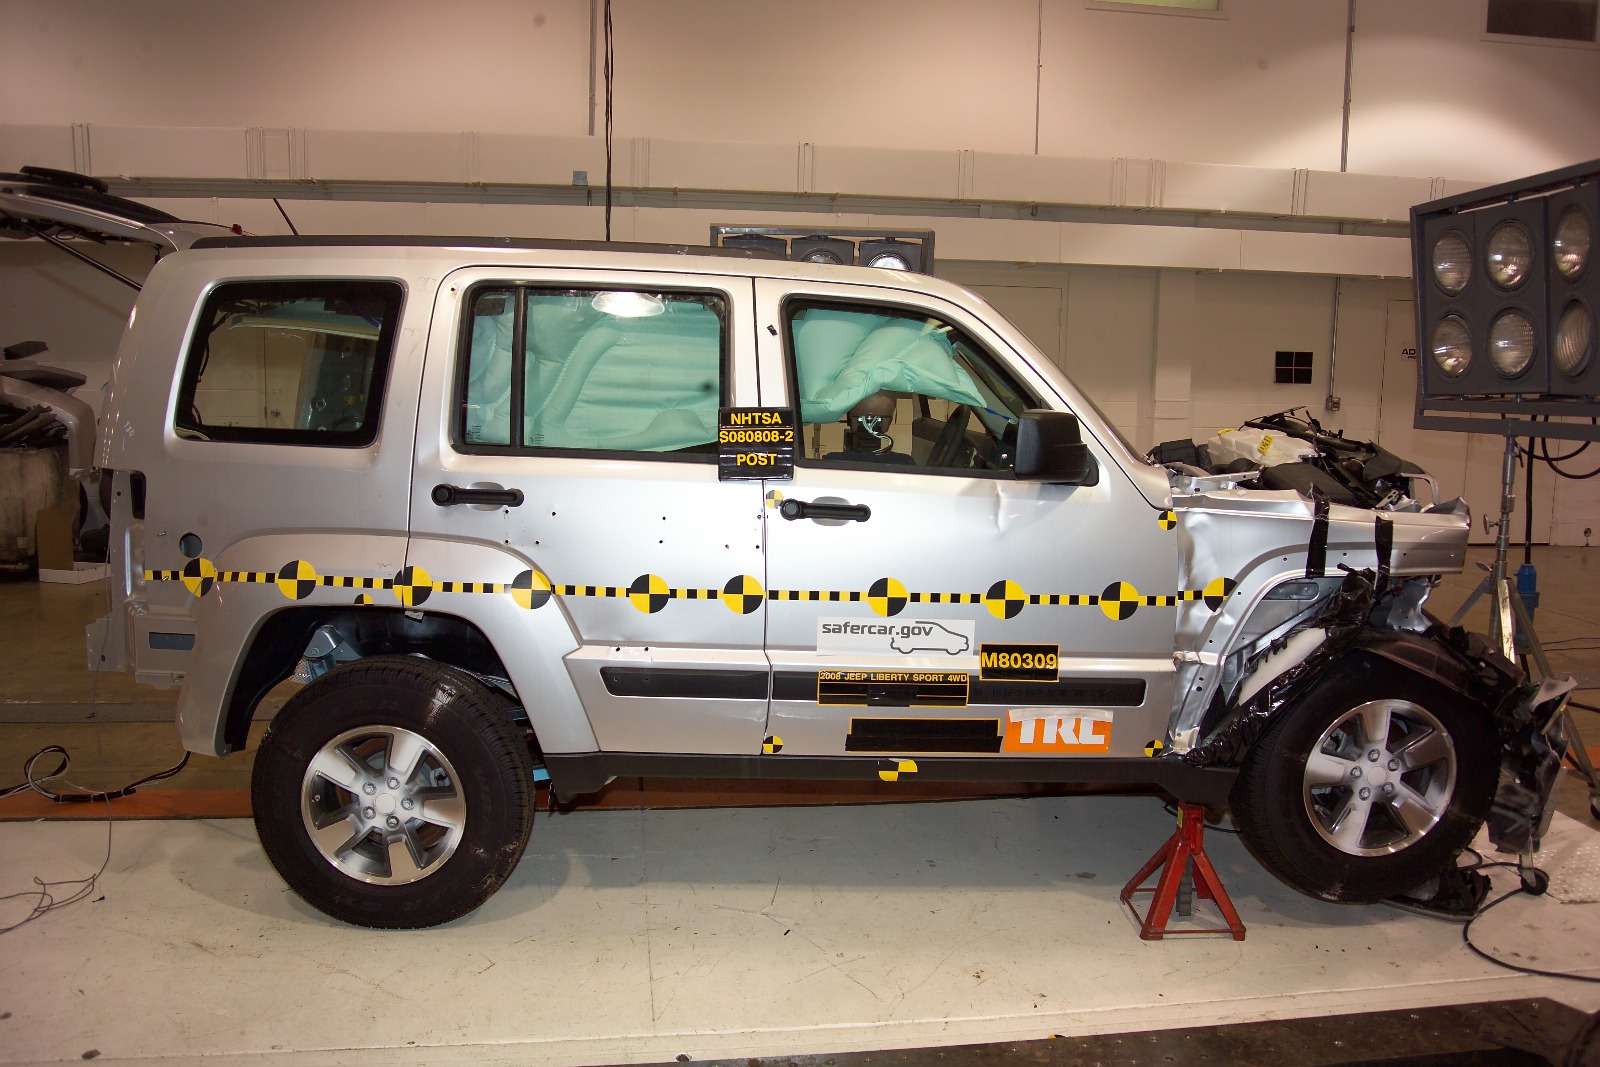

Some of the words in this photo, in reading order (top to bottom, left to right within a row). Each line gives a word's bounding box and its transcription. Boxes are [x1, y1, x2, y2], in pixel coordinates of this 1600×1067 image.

[730, 412, 782, 425] NHTSA
[719, 430, 794, 443] S080808-2
[736, 453, 777, 466] POST
[822, 621, 933, 639] safercar.gov
[981, 652, 1058, 669] M80309
[820, 672, 841, 680] 2008
[844, 673, 867, 681] JEEP
[870, 673, 909, 682] LIBERTY
[912, 673, 944, 682] SPORT
[947, 674, 967, 682] 4WD
